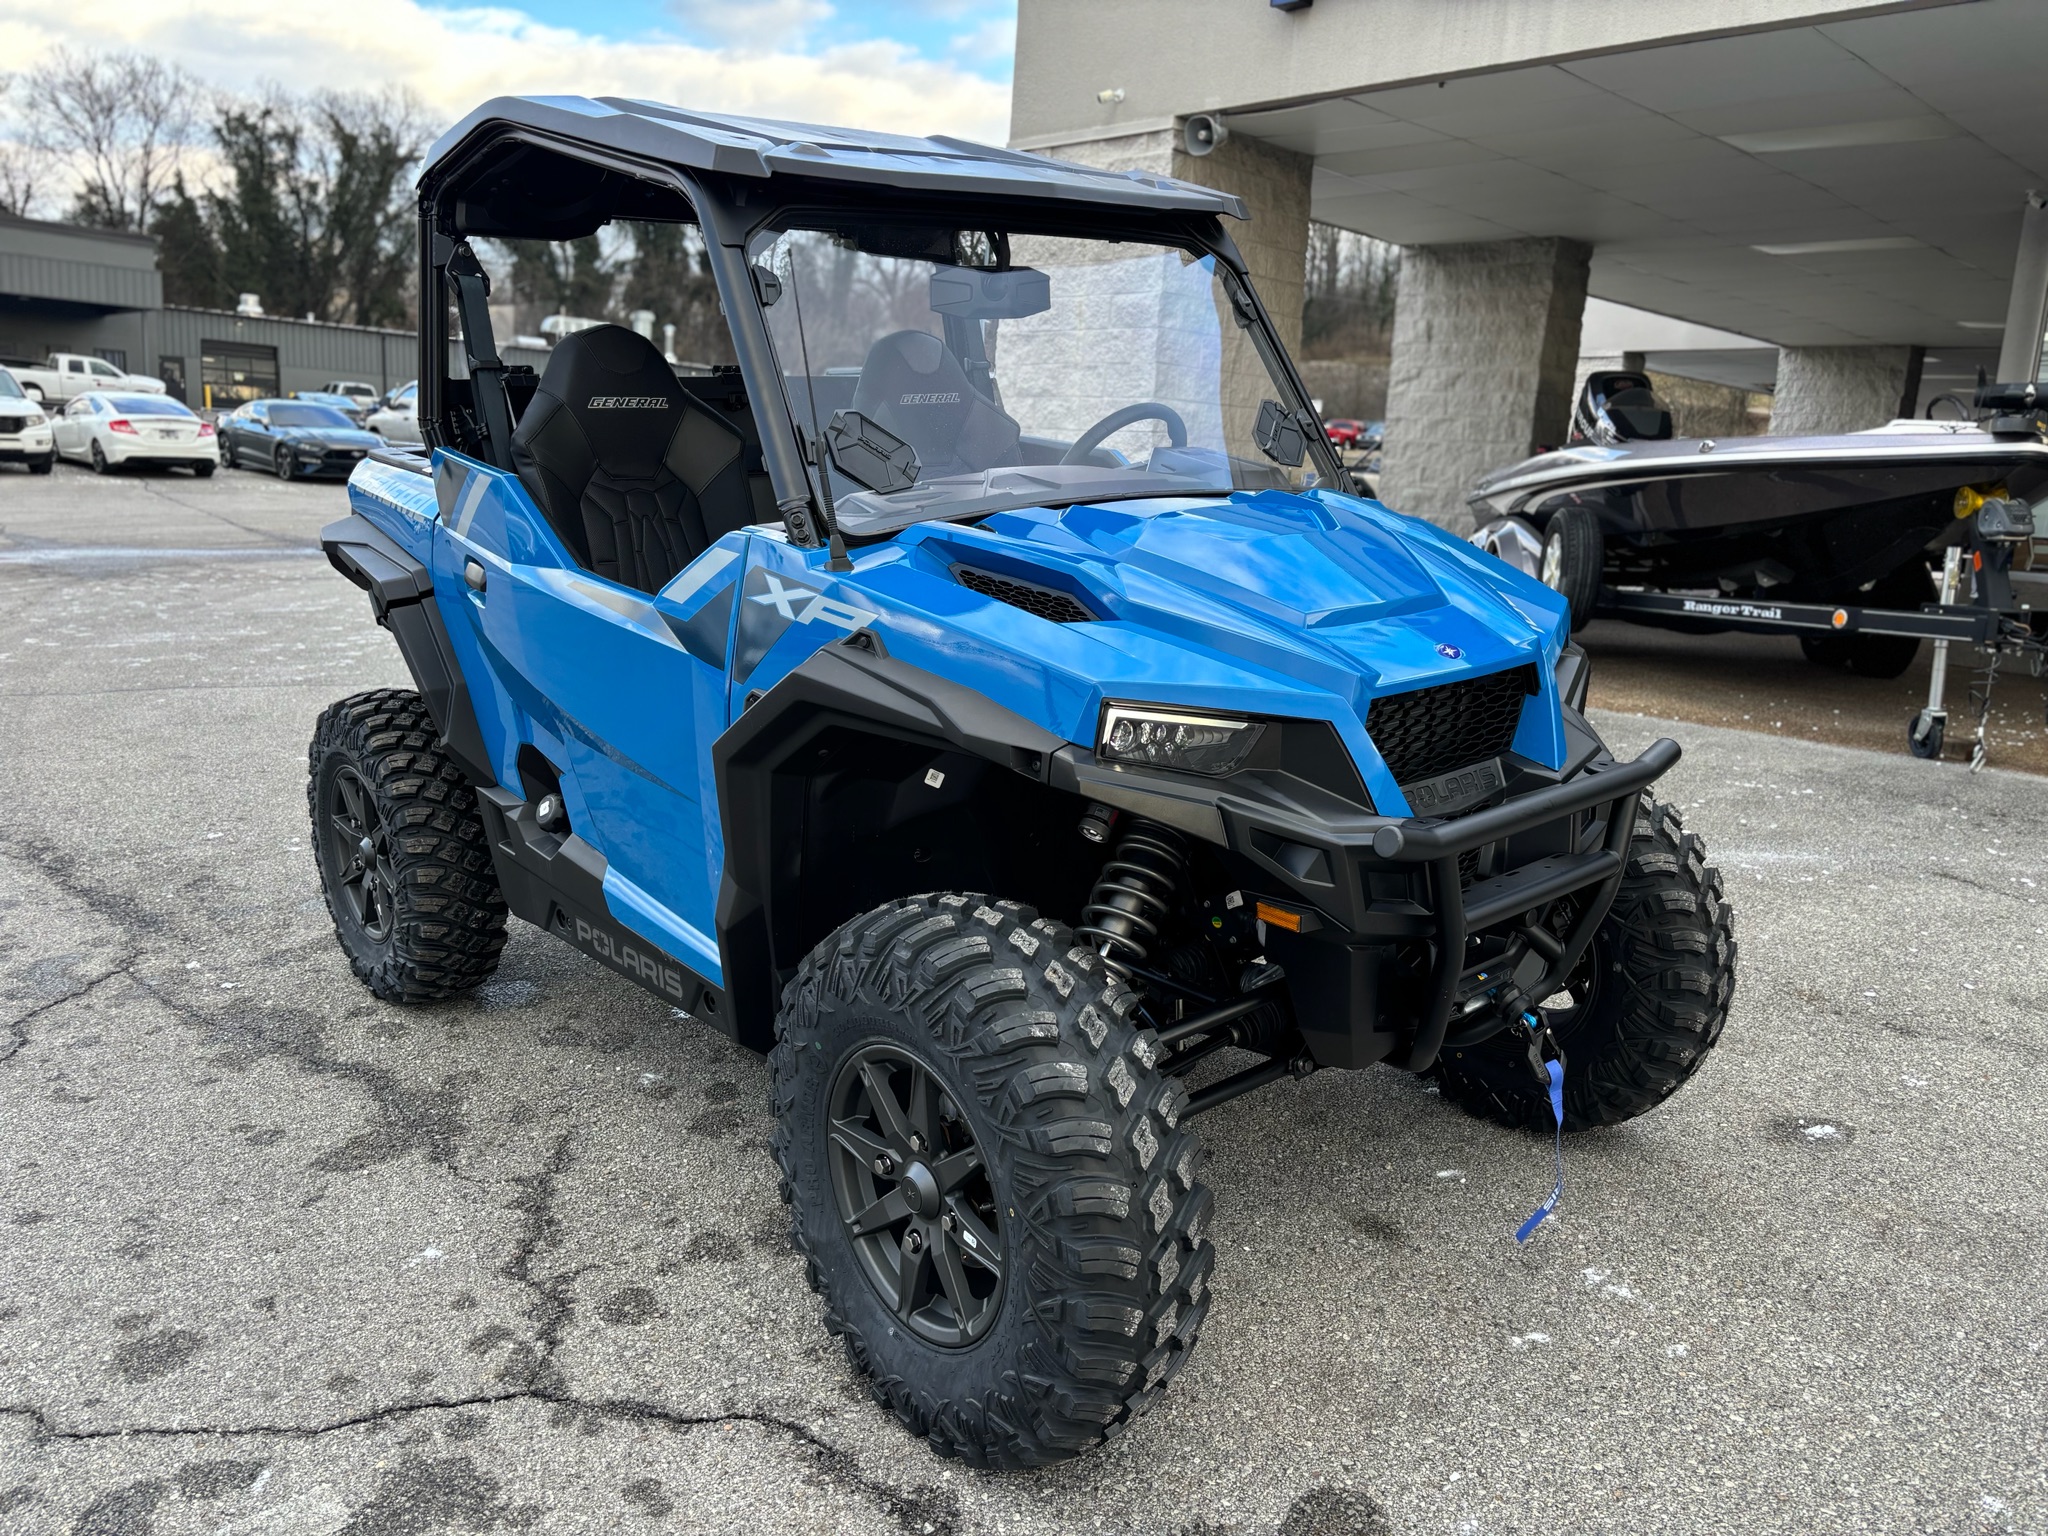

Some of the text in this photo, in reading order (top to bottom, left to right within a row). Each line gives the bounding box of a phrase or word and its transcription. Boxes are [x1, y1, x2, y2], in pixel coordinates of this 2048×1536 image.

[587, 396, 669, 409] GENERAL
[900, 392, 960, 405] GENERAL
[746, 572, 881, 632] XP
[1683, 600, 1783, 620] Ranger Trail
[575, 917, 684, 999] POLARIS
